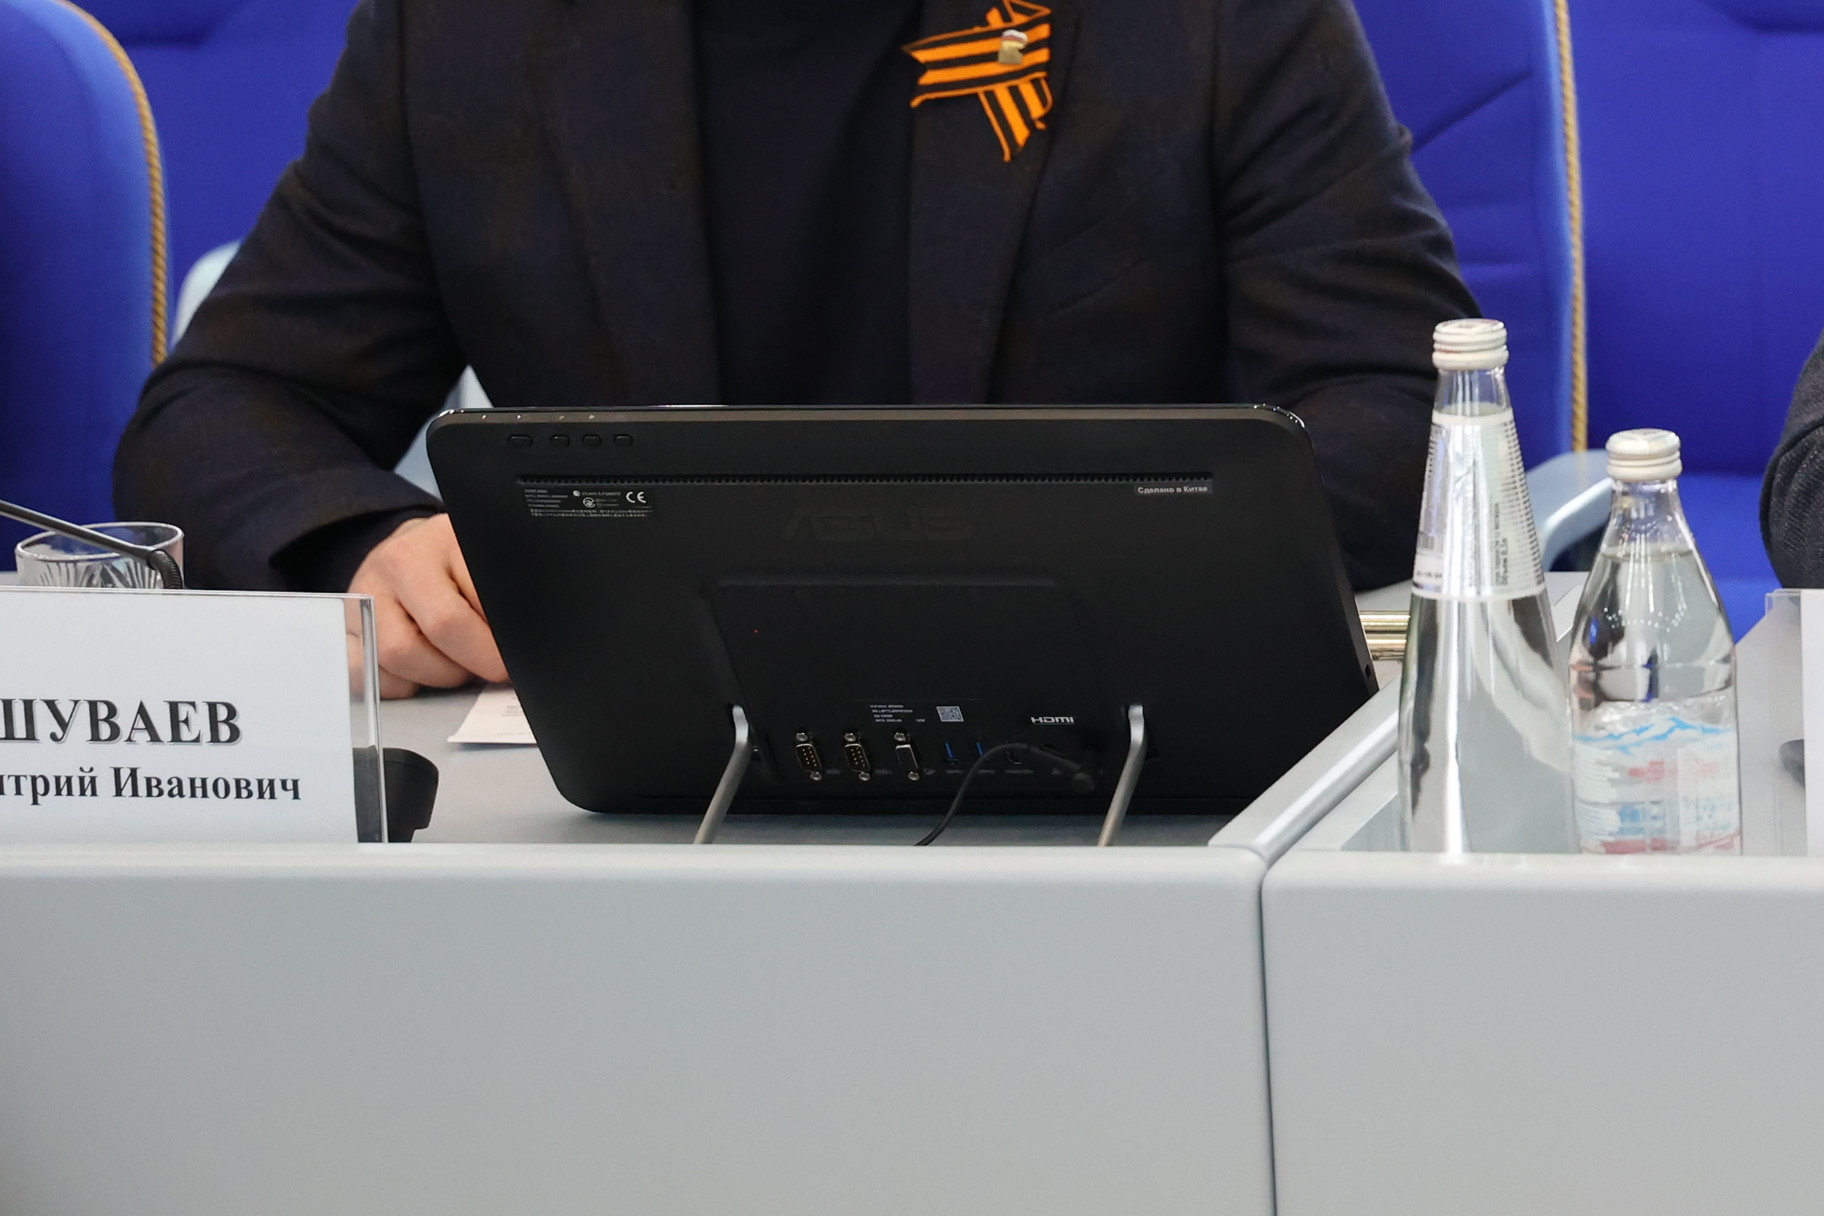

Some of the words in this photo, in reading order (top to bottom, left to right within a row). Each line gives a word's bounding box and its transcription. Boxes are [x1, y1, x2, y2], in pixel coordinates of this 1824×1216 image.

[1137, 486, 1175, 495] Сделано
[0, 698, 242, 744] ШУВАЕВ
[0, 766, 98, 806] трий
[111, 766, 301, 801] Иванович
